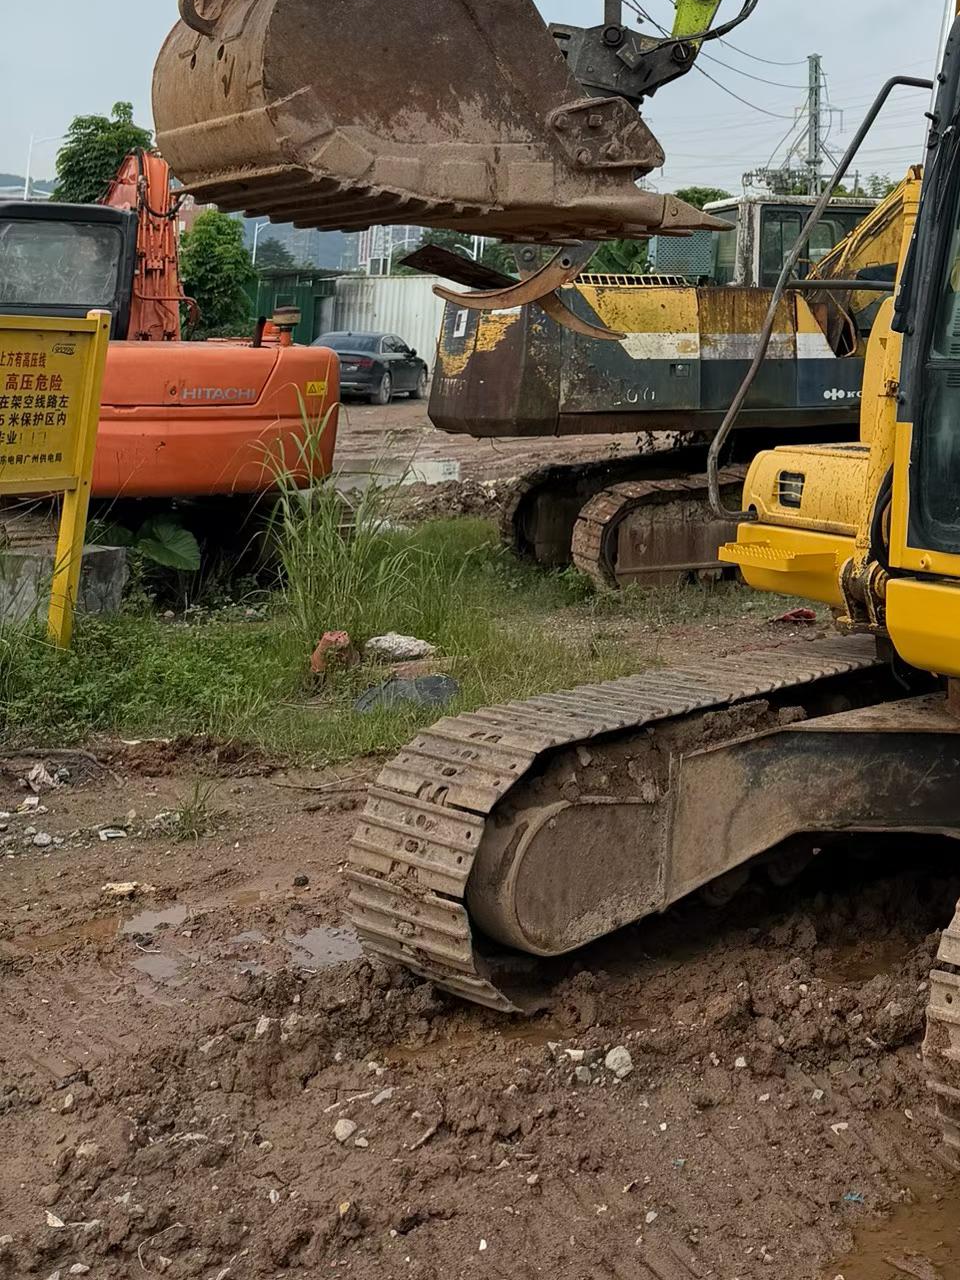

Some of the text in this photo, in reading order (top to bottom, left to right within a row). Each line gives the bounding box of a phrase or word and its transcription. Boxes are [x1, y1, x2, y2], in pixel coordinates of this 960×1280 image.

[0, 351, 47, 368] 上方有高压线
[5, 373, 63, 391] 高压危险
[181, 387, 256, 400] HITACHI
[0, 395, 69, 410] 在架空线路左
